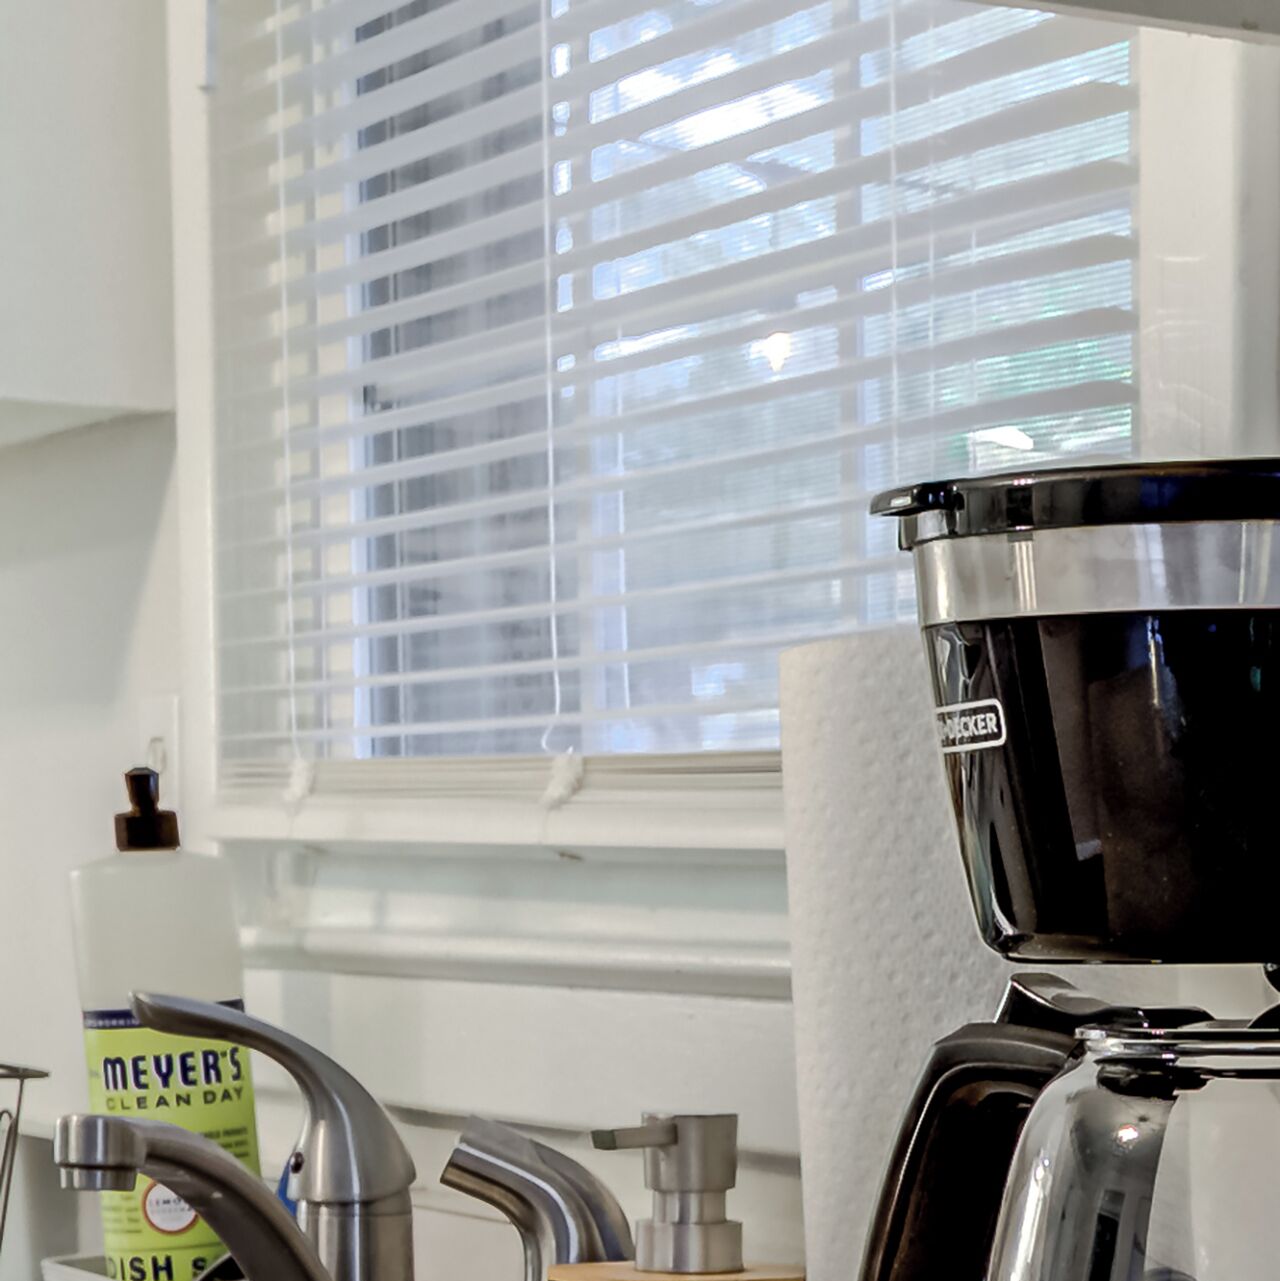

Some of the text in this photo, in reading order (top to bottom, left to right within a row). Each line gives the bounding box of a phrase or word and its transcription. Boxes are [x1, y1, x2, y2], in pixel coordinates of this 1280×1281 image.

[103, 1047, 242, 1091] MEYER'S
[106, 1087, 243, 1110] CLEAN DAY
